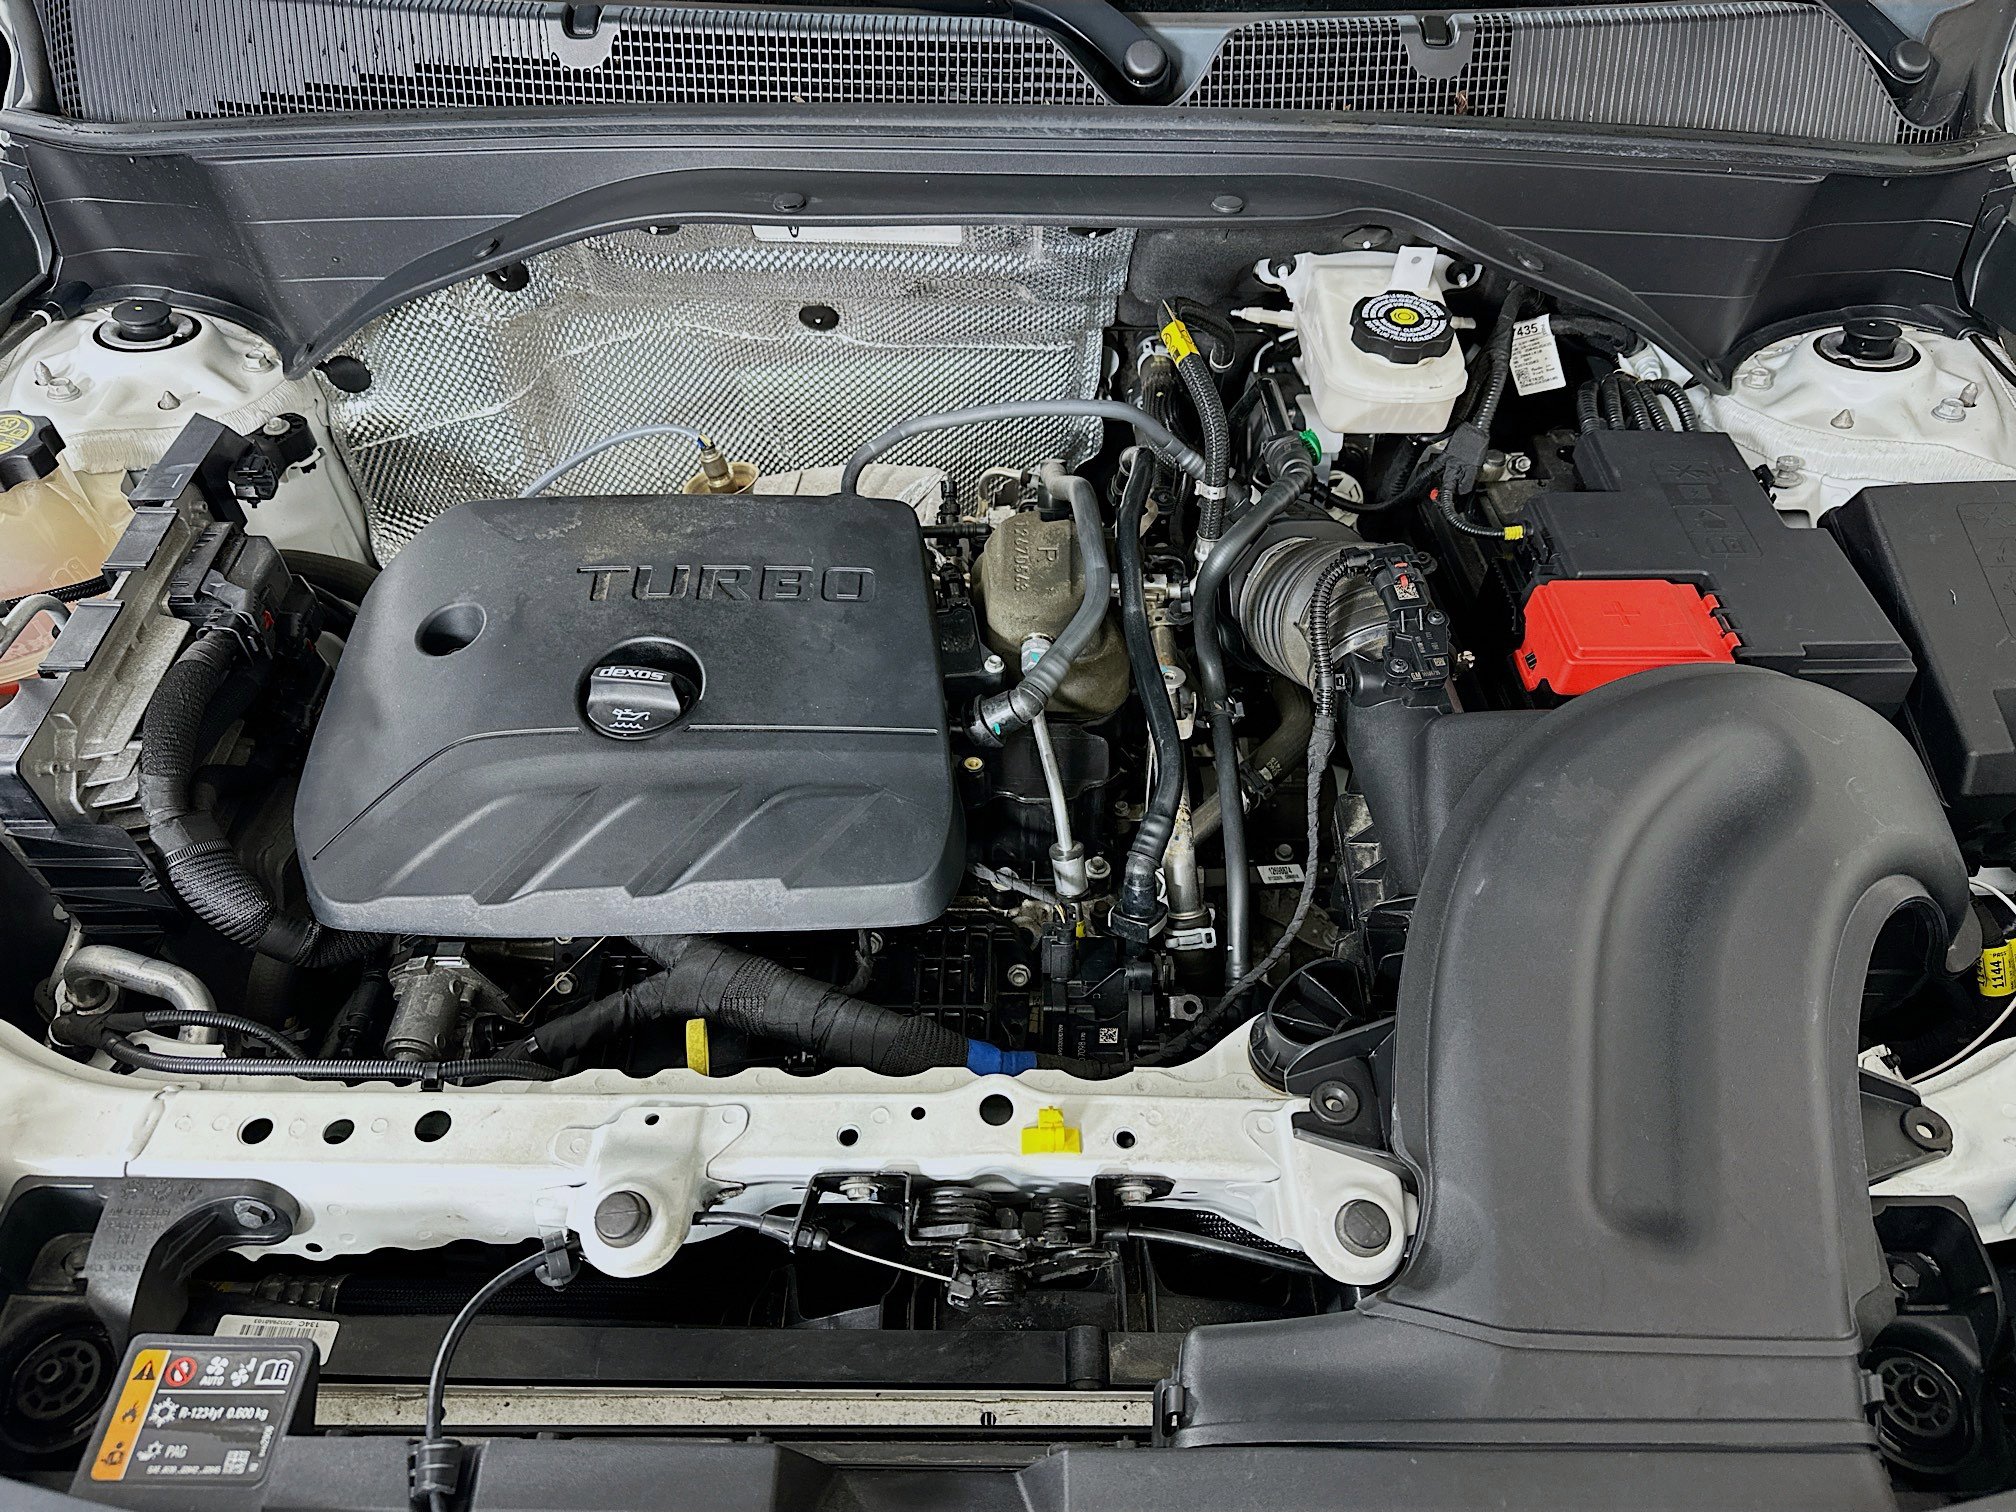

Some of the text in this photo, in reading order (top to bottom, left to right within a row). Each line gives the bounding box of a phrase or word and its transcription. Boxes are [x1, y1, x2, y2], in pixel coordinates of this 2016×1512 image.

[1513, 322, 1539, 337] 435
[577, 564, 876, 602] TURBO
[599, 666, 667, 681] dexos
[1989, 960, 2005, 989] 1144
[199, 1375, 225, 1387] AUTO
[164, 1445, 189, 1459] PAG
